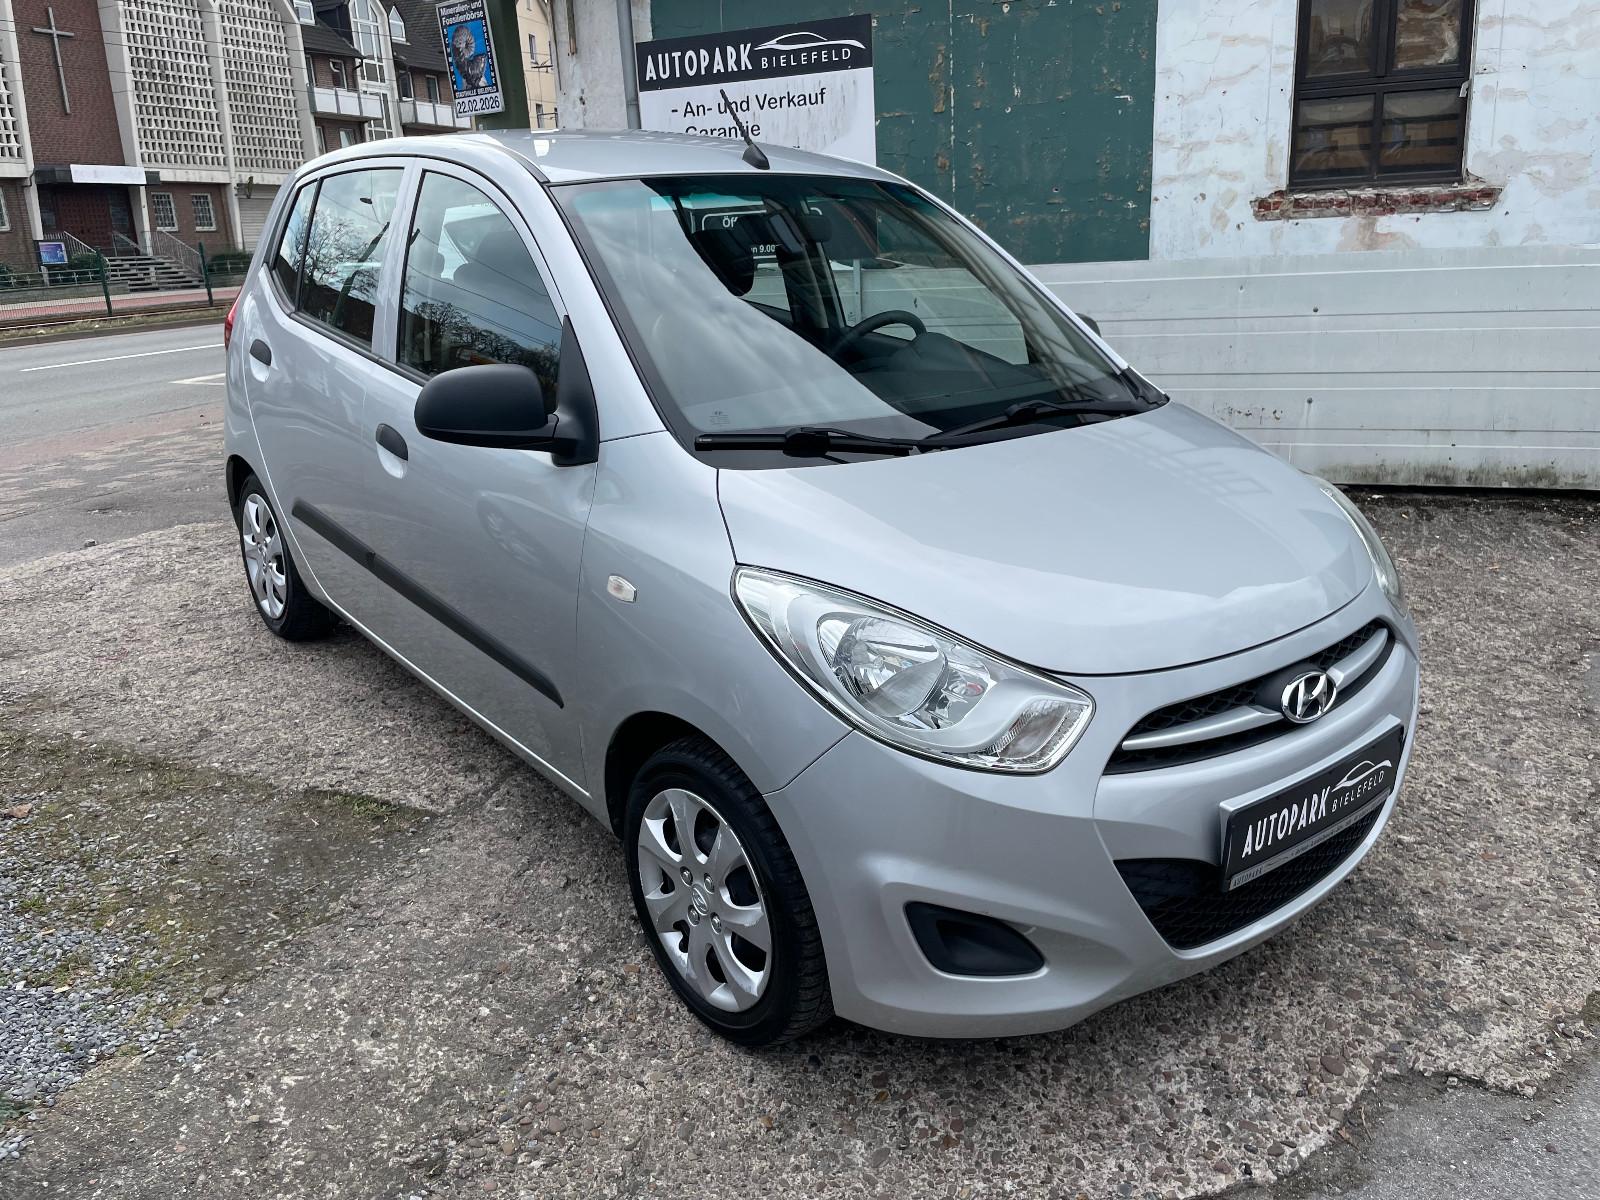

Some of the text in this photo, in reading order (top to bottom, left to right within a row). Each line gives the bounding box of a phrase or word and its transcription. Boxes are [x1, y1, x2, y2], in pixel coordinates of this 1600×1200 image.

[440, 0, 482, 16] Mineralien- und
[442, 10, 484, 26] Fossilienbörse
[482, 19, 496, 84] EDELSTEINE
[645, 43, 851, 81] AUTOPARK BIELEFELD
[456, 95, 500, 114] 22.02.2026
[683, 101, 713, 118] An-
[717, 95, 750, 115] und
[755, 87, 827, 111] Verkauf
[1241, 785, 1331, 858] AUTOPARK
[1331, 770, 1385, 813] BIELEFELD
